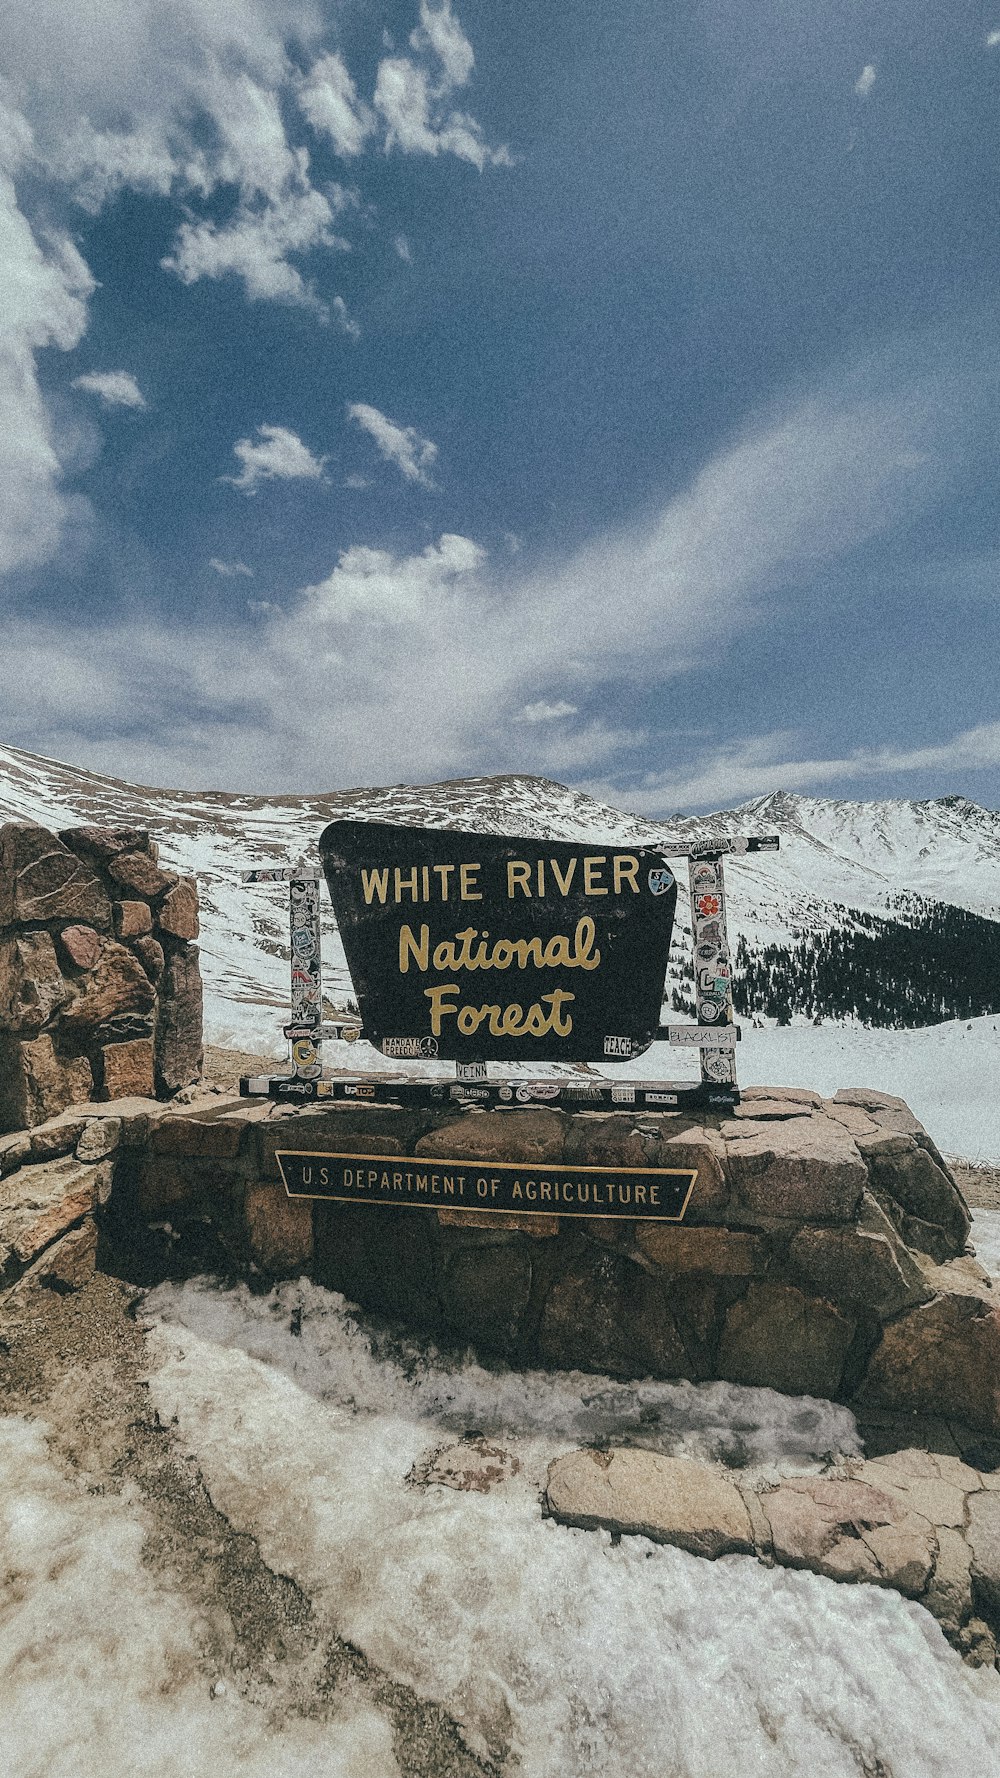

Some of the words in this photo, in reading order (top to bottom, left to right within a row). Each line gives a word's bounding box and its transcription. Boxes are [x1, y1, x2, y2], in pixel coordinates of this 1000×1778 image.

[361, 863, 483, 904] WHITE
[507, 856, 640, 899] RIVER
[399, 915, 601, 974] National
[424, 983, 576, 1037] Forest
[385, 1038, 420, 1047] MANDATE
[604, 1036, 632, 1056] TEACH
[670, 1031, 735, 1043] BLACKLIST
[301, 1167, 334, 1185] U.S.
[343, 1169, 466, 1197] DEPARTMENT
[476, 1178, 502, 1198] OF
[511, 1180, 662, 1206] AGRICULTURE
